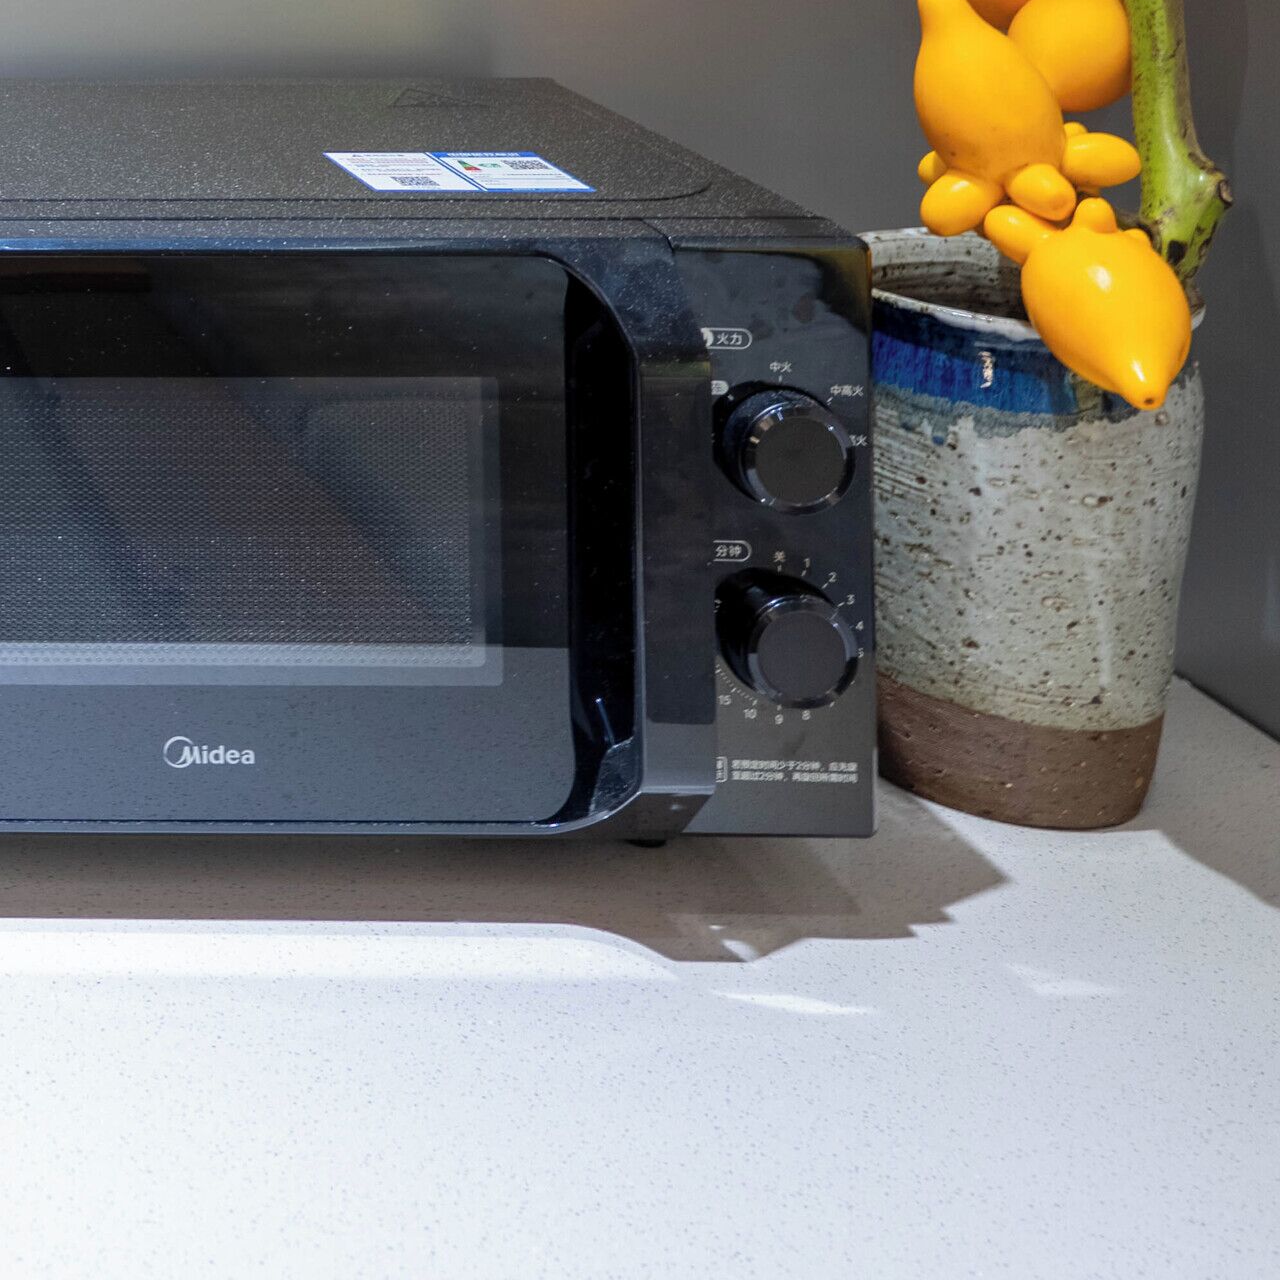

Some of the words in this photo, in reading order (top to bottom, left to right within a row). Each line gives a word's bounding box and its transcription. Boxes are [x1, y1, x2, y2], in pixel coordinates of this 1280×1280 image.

[717, 333, 743, 345] 火力
[770, 361, 792, 372] 中火
[830, 384, 864, 397] 中高火
[803, 558, 811, 568] 1
[828, 571, 837, 583] 2
[846, 594, 856, 605] 3
[855, 621, 864, 631] 4
[718, 694, 732, 706] 15
[743, 708, 757, 720] 10
[774, 713, 784, 726] 9
[163, 736, 256, 768] Midea
